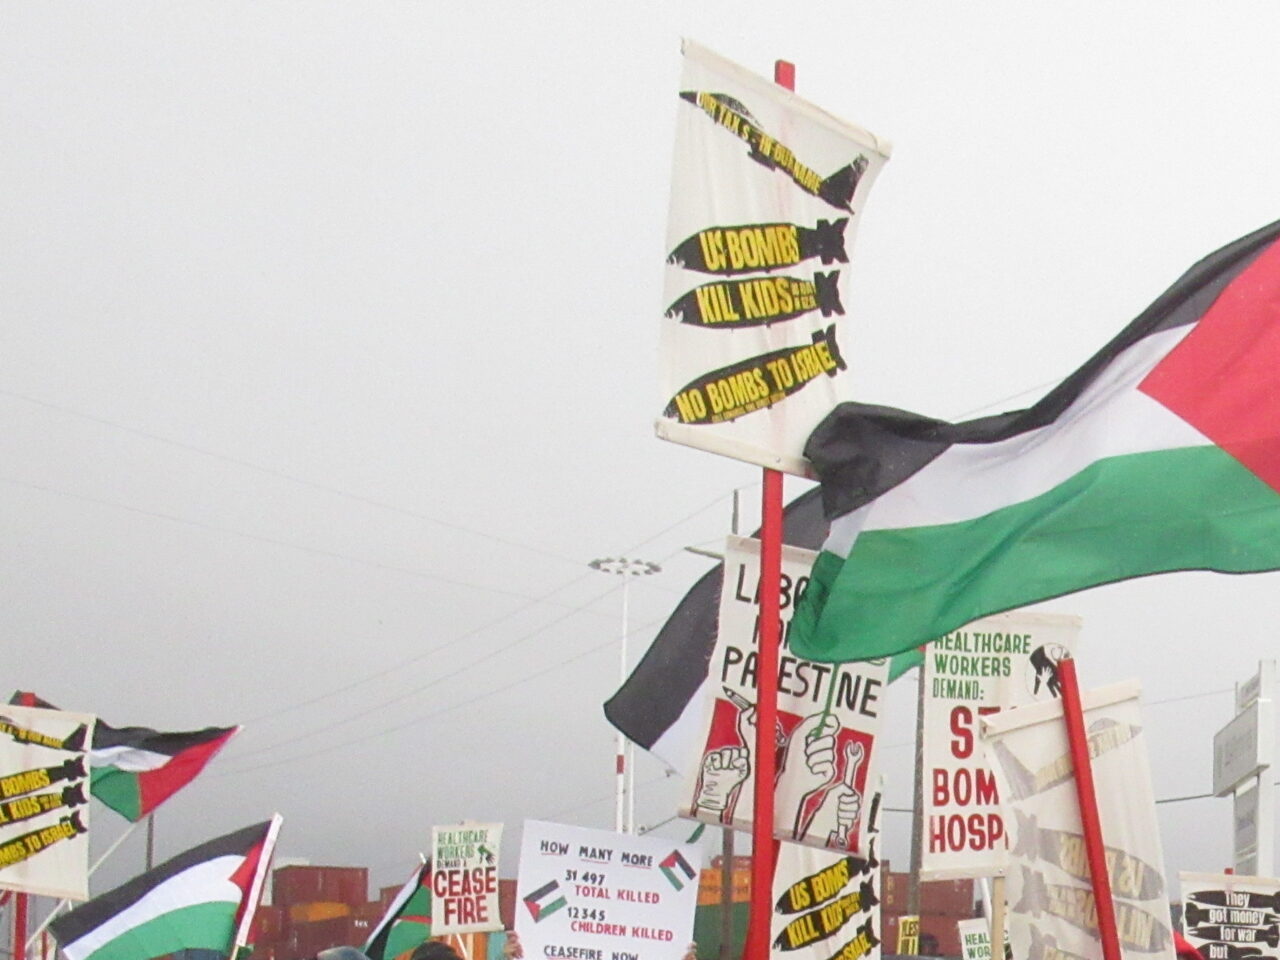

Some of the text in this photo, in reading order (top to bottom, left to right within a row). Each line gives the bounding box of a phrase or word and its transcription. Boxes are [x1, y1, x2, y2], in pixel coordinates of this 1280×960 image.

[700, 225, 800, 271] US BOMBS
[696, 285, 740, 323] KILL
[739, 277, 793, 319] KIDS
[676, 388, 707, 423] NO
[706, 368, 769, 414] BOMBS
[767, 358, 793, 390] TO
[791, 340, 836, 382] ISRAEL
[934, 633, 1032, 654] HEALTHCARE
[935, 654, 1011, 677] WORKERS
[933, 678, 984, 700] DEMAND:
[1, 769, 50, 796] BOMBS
[933, 768, 999, 807] BOM
[9, 796, 41, 819] KIDS
[40, 820, 75, 845] ISRAEL
[929, 813, 1009, 853] HOSP
[540, 840, 653, 867] HOW MANY MORE
[433, 866, 496, 898] CEASE
[575, 885, 660, 904] TOTAL KILLED
[789, 882, 811, 911] US
[1224, 891, 1250, 908] They
[444, 895, 488, 925] FIRE
[1209, 909, 1265, 927] got money
[571, 921, 674, 942] CHILDREN KILLED
[786, 914, 820, 948] KILL
[964, 933, 990, 946] HEAL
[1220, 925, 1257, 942] for war
[967, 946, 991, 959] WOR
[1209, 945, 1228, 960] but
